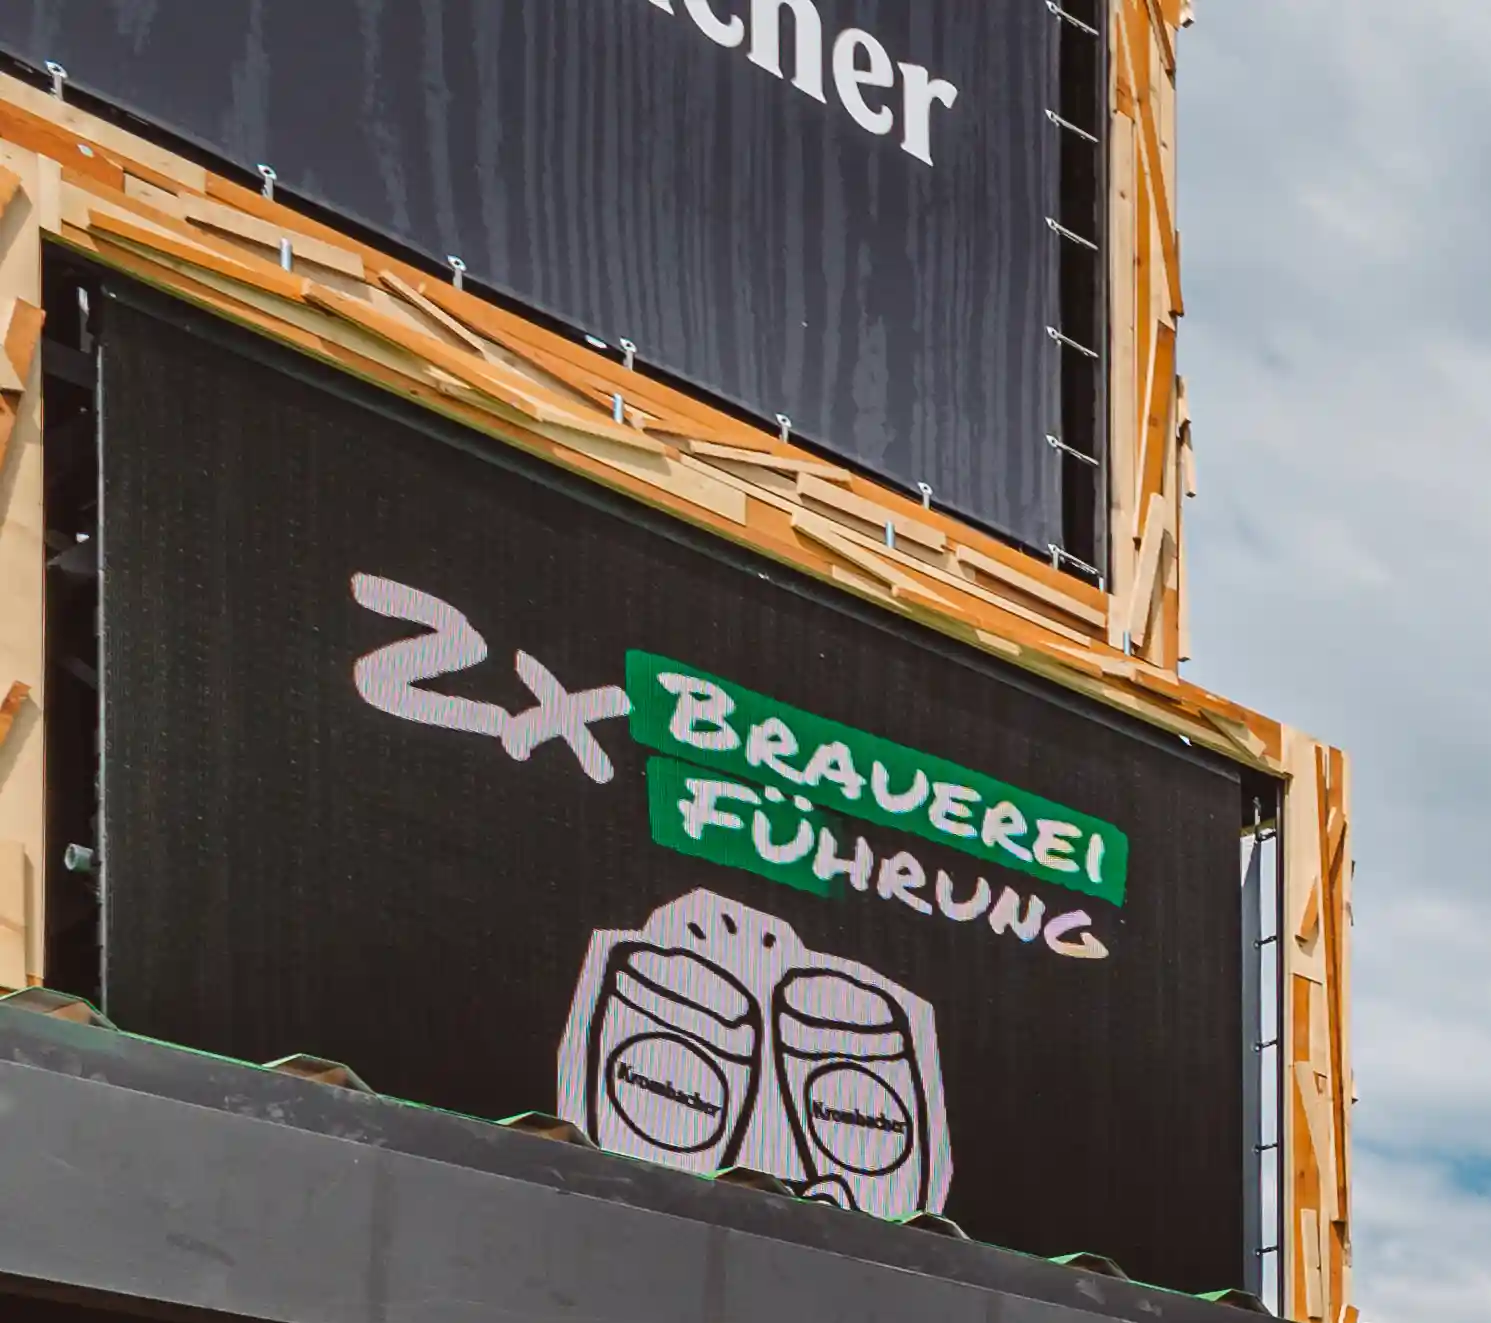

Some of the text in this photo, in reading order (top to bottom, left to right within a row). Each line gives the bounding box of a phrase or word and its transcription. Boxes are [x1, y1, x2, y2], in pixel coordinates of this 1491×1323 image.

[656, 671, 1106, 885] BRAUEREI
[678, 777, 1108, 959] FÜHRUNG
[617, 1061, 722, 1118] Krombacher
[814, 1101, 907, 1135] Krombacher
